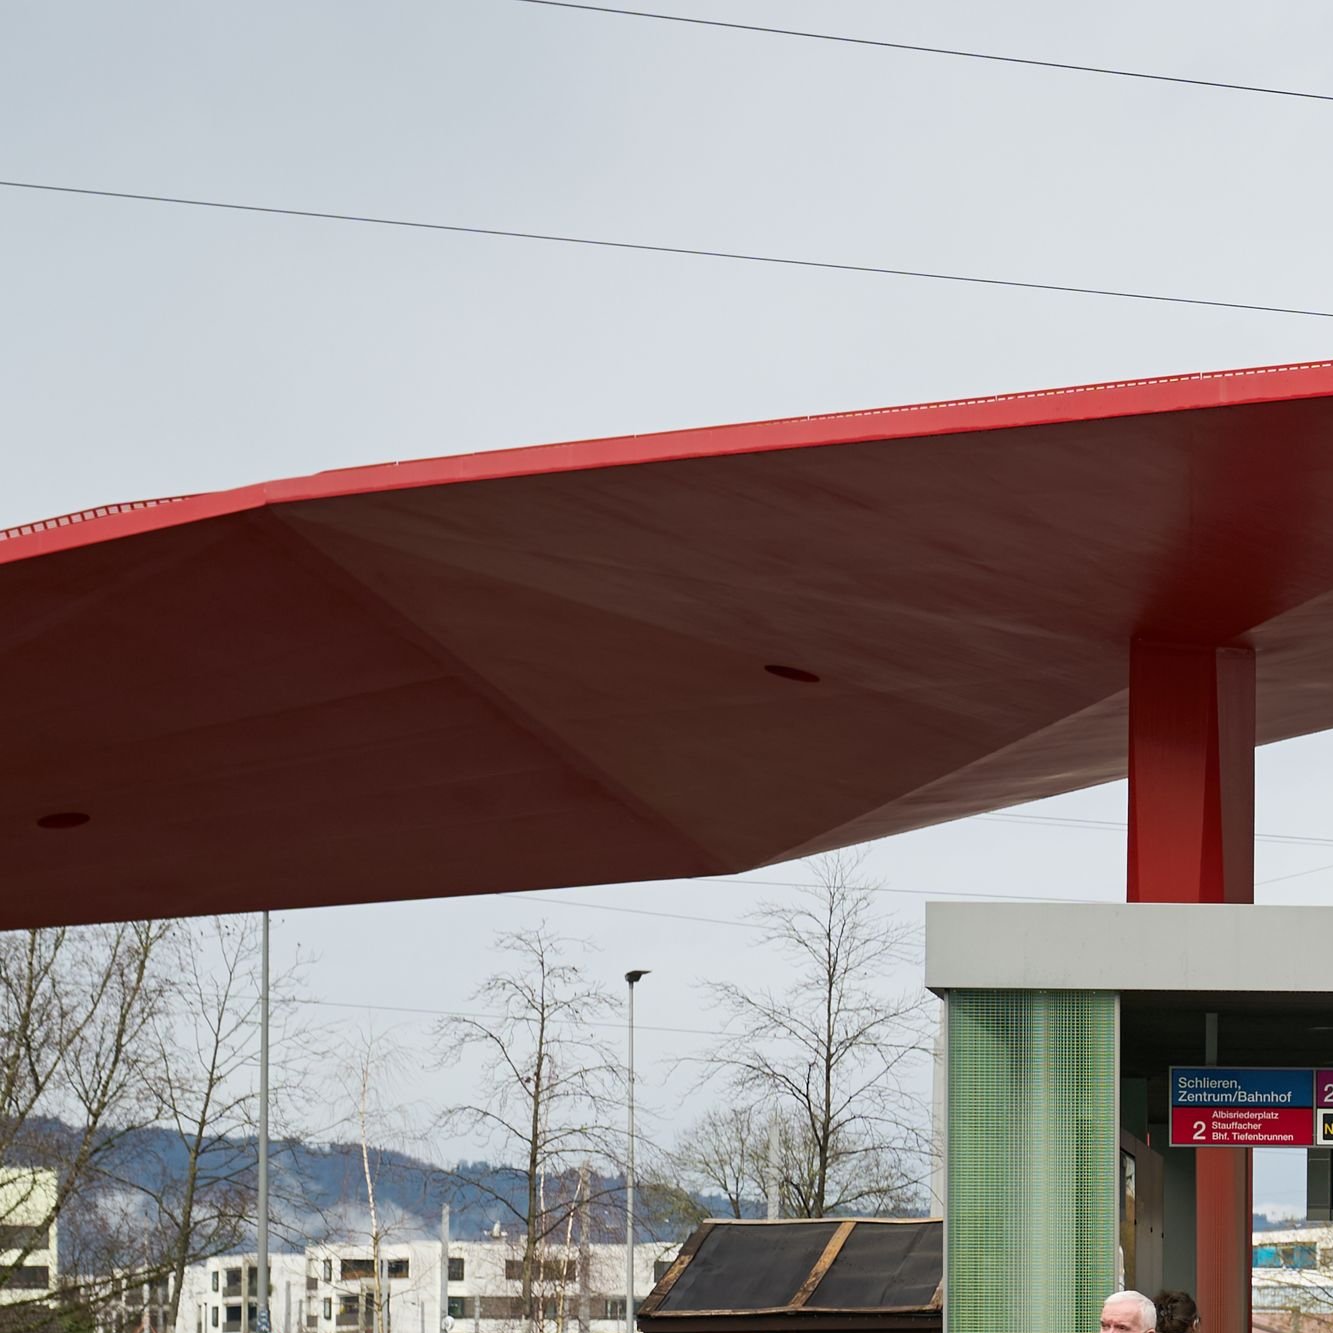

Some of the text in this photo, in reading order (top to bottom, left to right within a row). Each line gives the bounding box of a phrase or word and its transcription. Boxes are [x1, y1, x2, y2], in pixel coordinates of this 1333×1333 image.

[1178, 1076, 1241, 1091] Schlieren,
[1178, 1090, 1292, 1103] Zentrum/Bahnhof
[1211, 1110, 1279, 1121] Albisriederplatz
[1192, 1120, 1206, 1140] 2
[1211, 1121, 1262, 1130] Stauffacher
[1211, 1132, 1294, 1141] Bhf. Tiefenbrunnen
